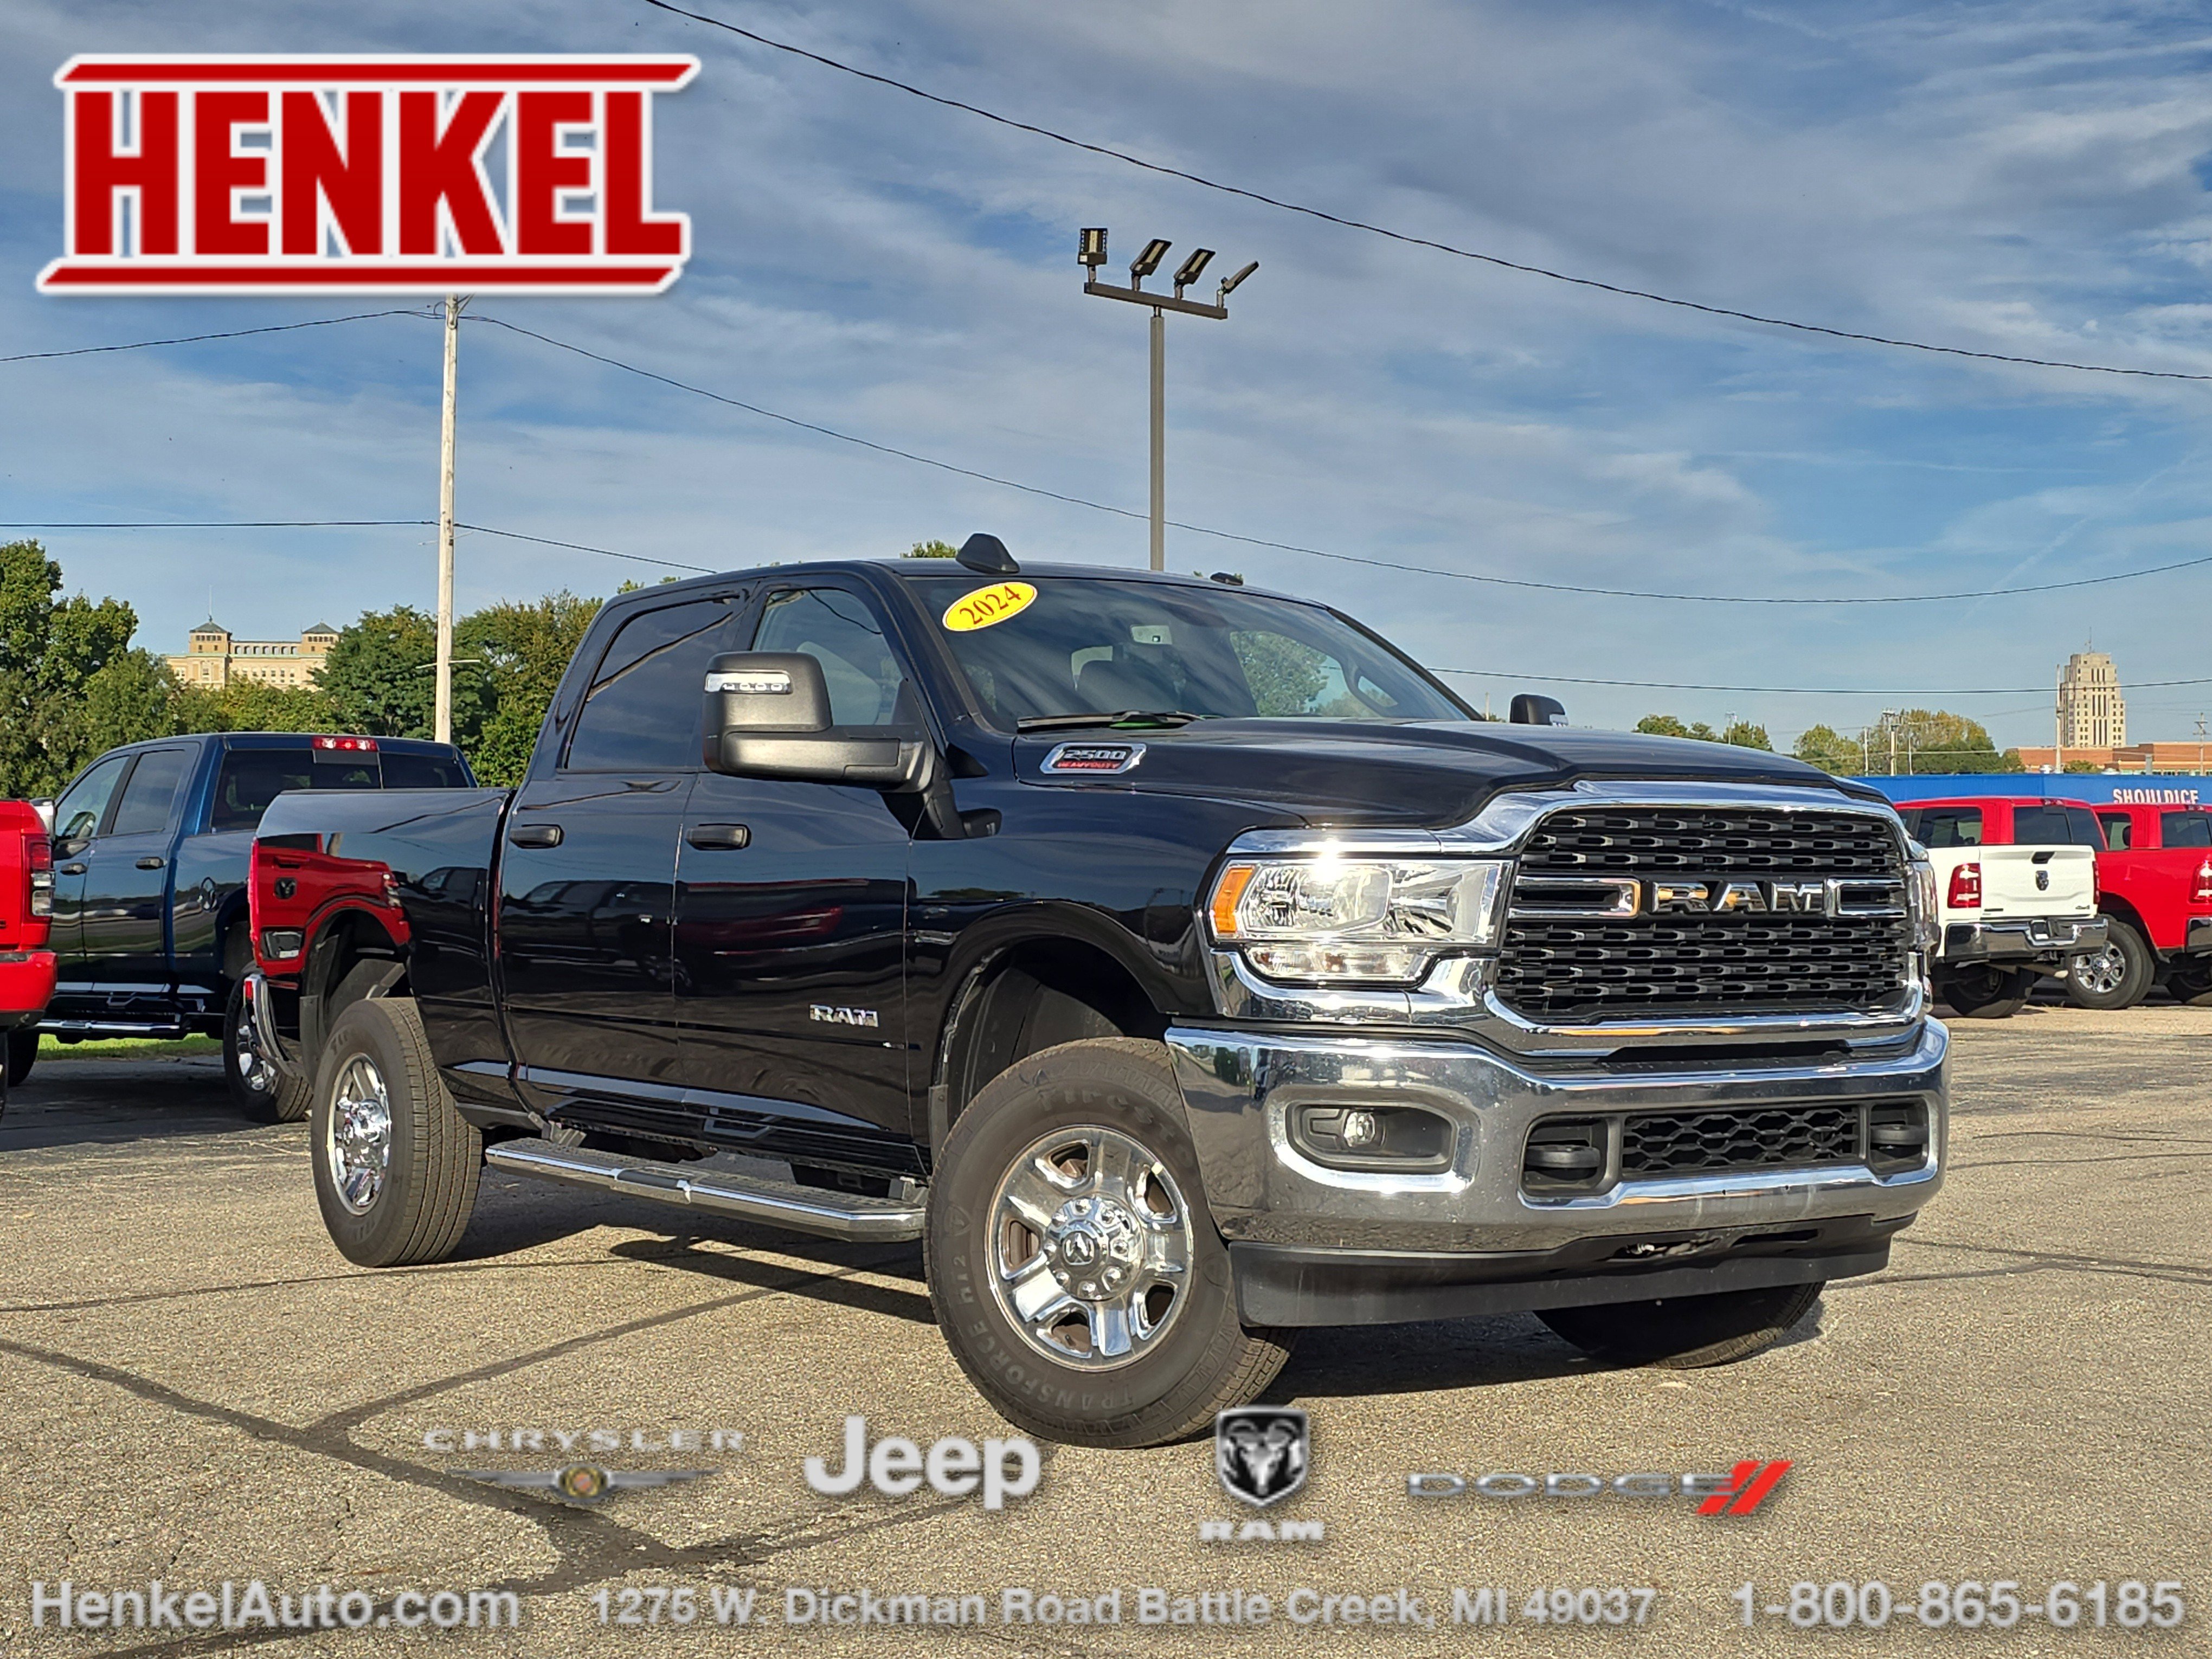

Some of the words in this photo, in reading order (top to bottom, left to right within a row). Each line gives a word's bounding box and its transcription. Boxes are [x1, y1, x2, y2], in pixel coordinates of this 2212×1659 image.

[960, 585, 1021, 625] 2024
[1063, 750, 1127, 760] 2500
[2113, 788, 2200, 805] SHOULDICE
[1651, 882, 1824, 913] RAM
[809, 1004, 879, 1028] RAM
